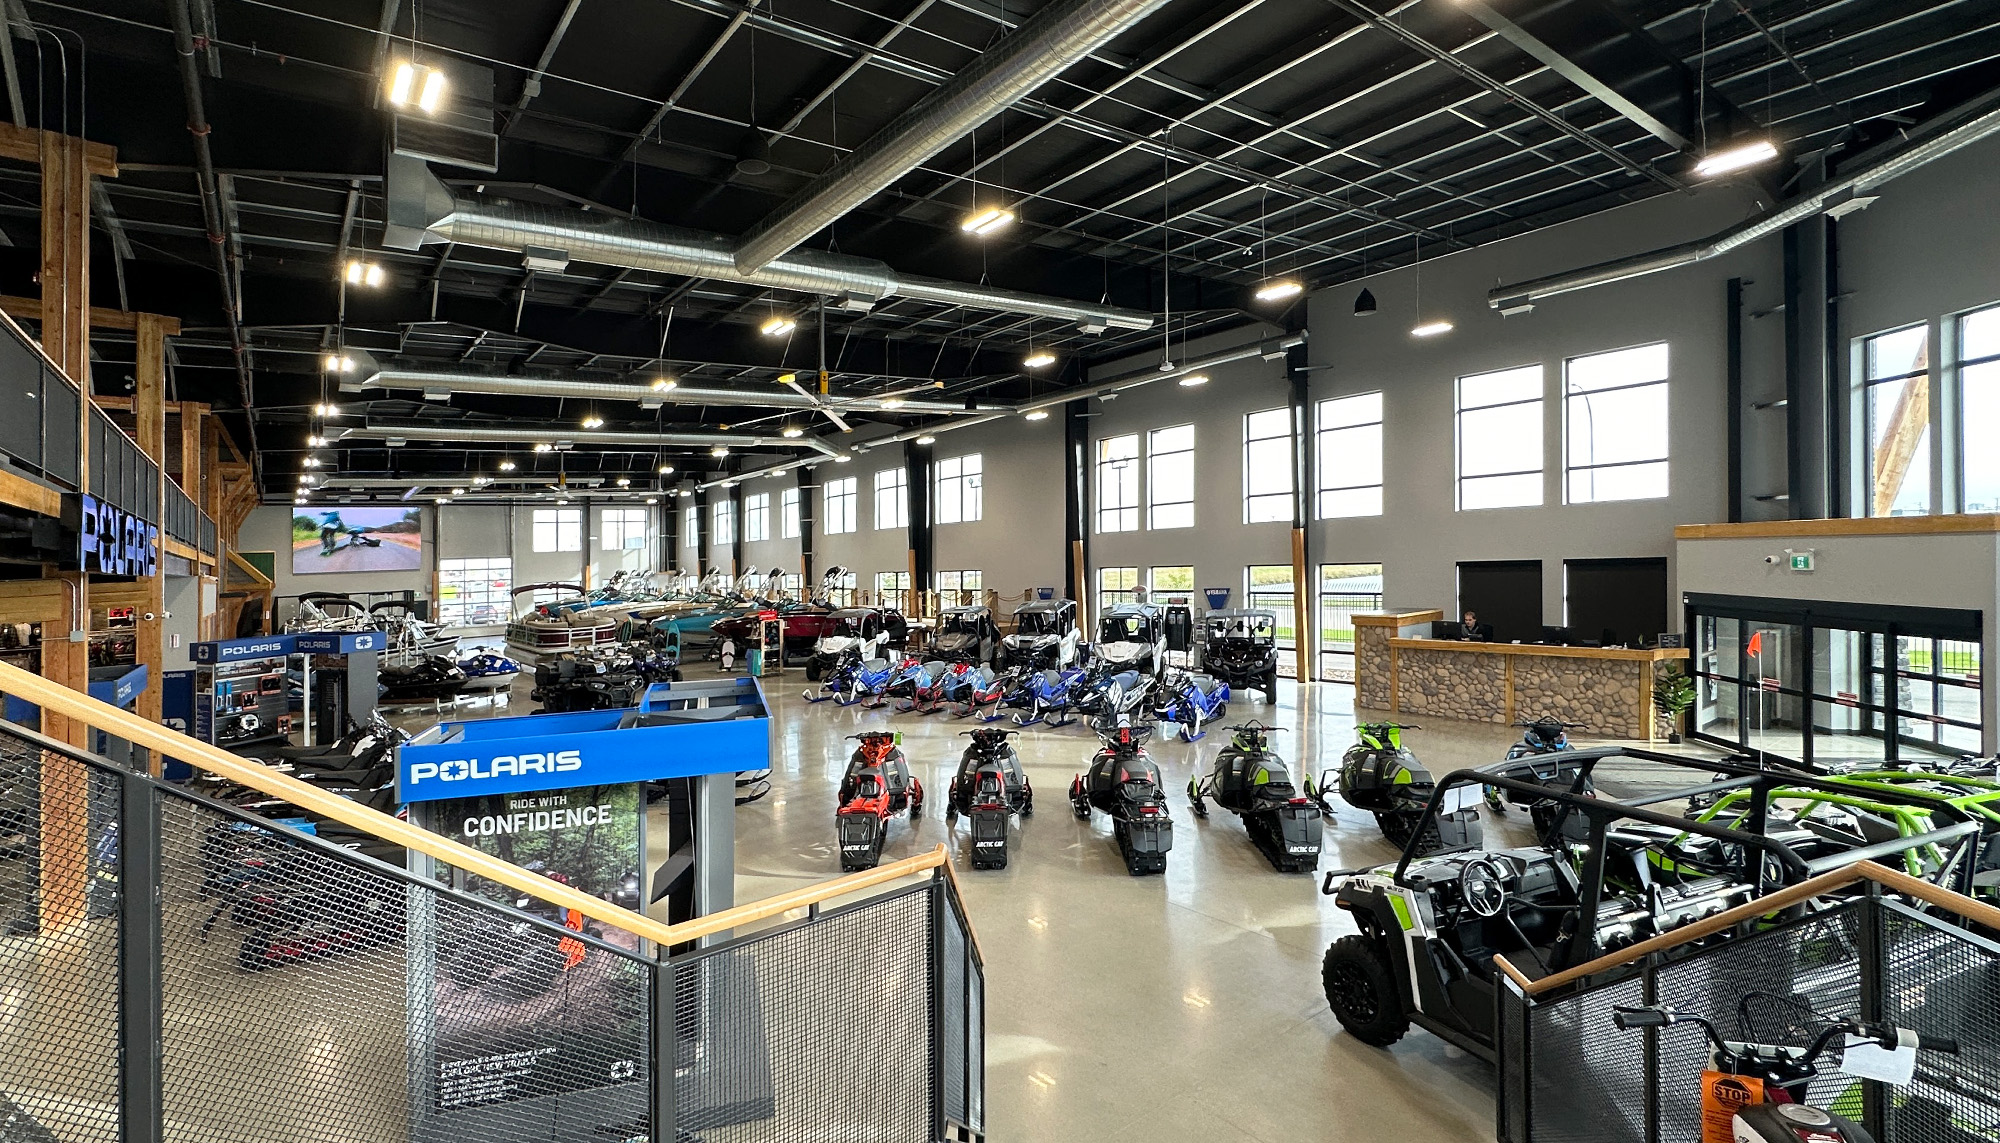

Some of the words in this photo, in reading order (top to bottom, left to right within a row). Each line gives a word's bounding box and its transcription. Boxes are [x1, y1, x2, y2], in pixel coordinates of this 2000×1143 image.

[81, 494, 157, 577] POLARIS
[222, 642, 282, 656] POLARIS
[299, 640, 331, 649] POLARIS
[410, 750, 583, 785] POLARIS
[510, 798, 536, 810] RIDE
[538, 795, 567, 808] WITH
[463, 804, 612, 837] CONFIDENCE
[1714, 1084, 1751, 1102] STOP
